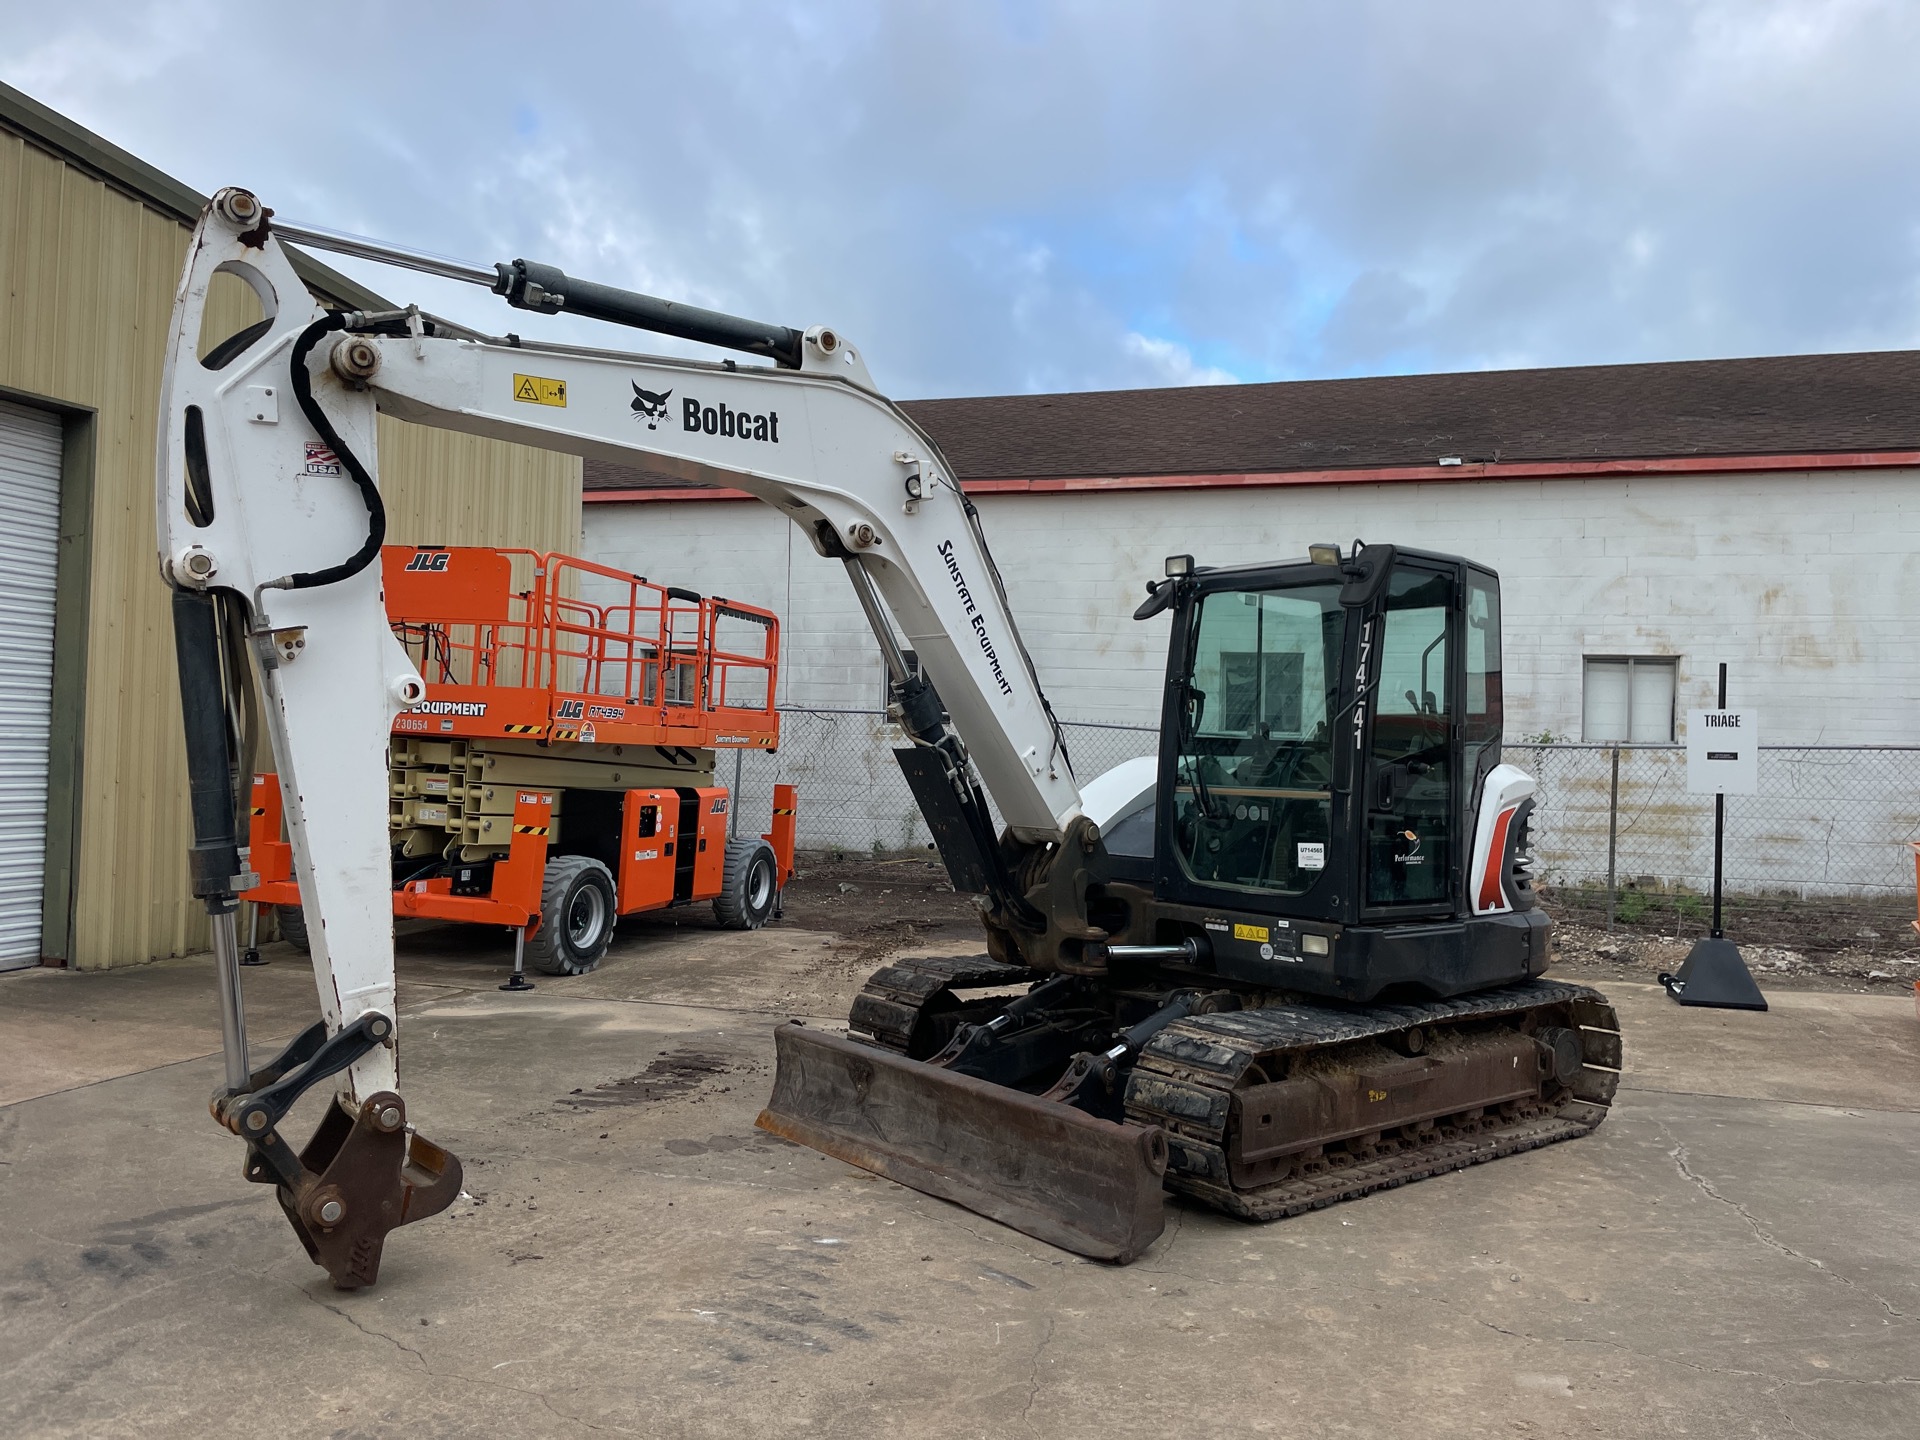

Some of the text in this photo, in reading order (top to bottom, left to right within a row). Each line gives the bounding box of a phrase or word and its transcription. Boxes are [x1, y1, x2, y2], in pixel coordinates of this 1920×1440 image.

[682, 397, 778, 443] Bobcat
[308, 465, 338, 474] USA
[404, 552, 450, 571] JLG
[937, 540, 1012, 695] SUNSTATE EQUIPMENT
[556, 700, 625, 719] JLG RT4394
[396, 719, 428, 730] 230654
[1704, 715, 1746, 727] TRIAGE
[710, 798, 727, 814] JLG
